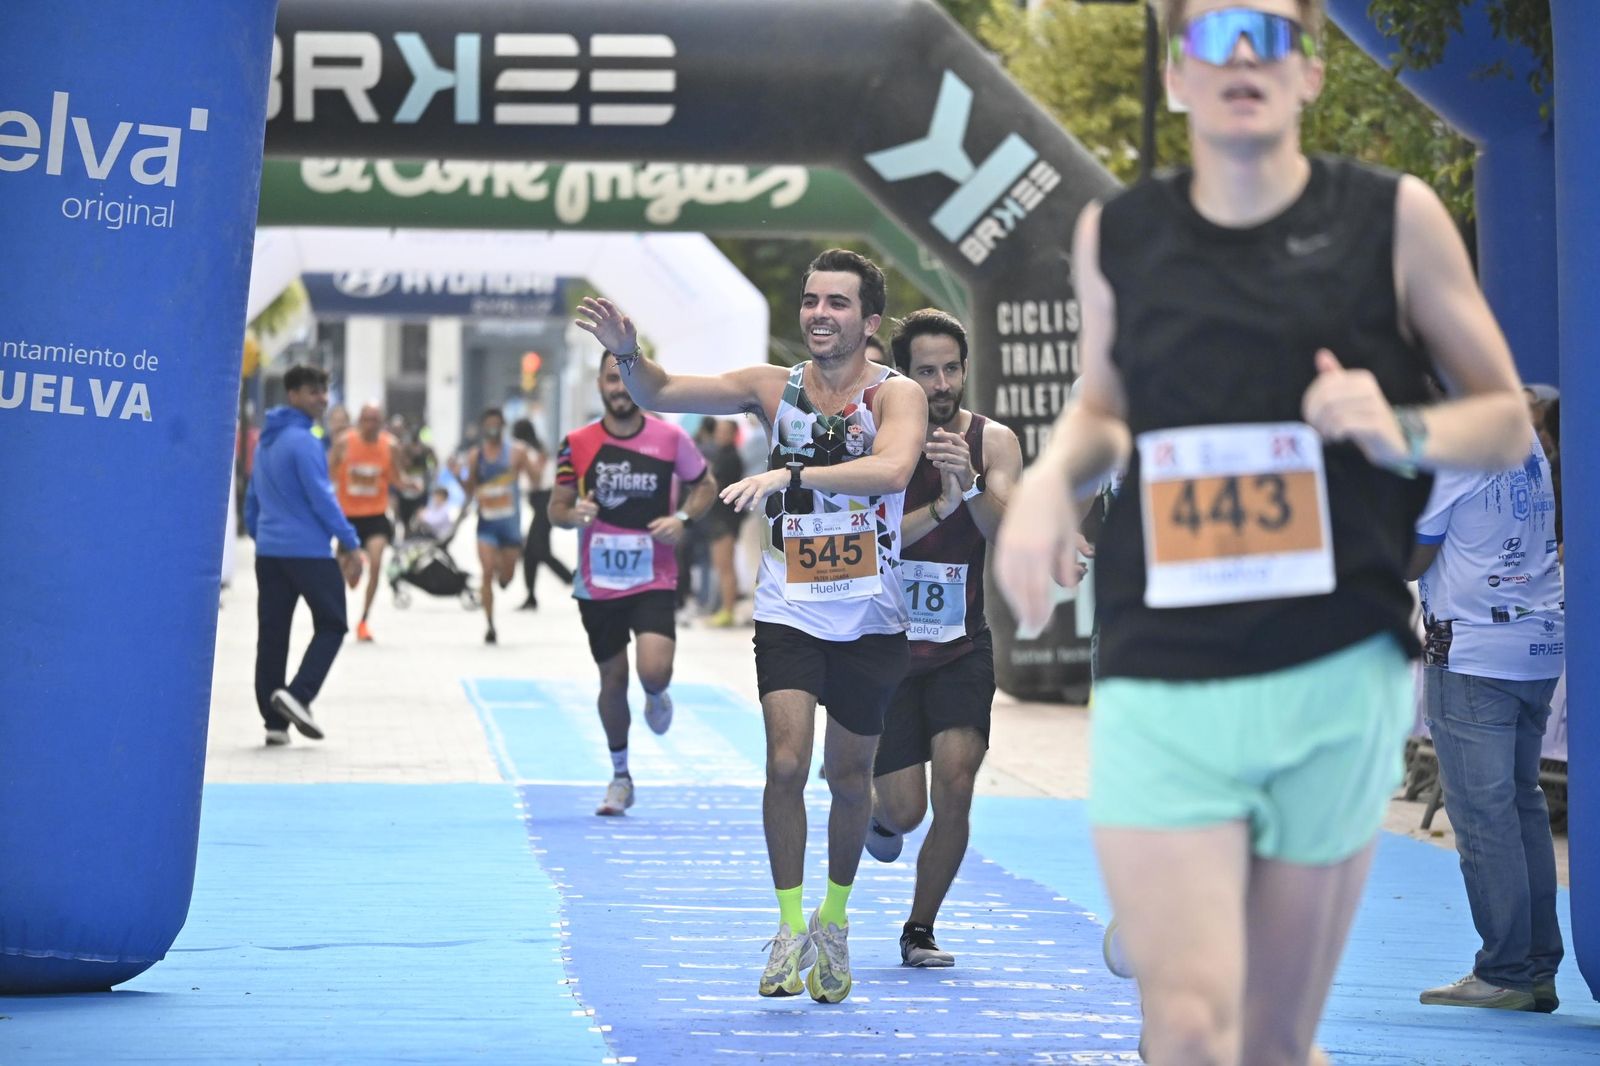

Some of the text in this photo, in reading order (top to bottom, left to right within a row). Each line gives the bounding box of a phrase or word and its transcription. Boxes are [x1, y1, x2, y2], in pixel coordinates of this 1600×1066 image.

[61, 193, 175, 230] original
[133, 350, 159, 371] de
[1171, 475, 1293, 534] 443
[787, 518, 803, 531] 2K
[851, 512, 870, 526] 2K
[602, 549, 643, 570] 107
[799, 535, 862, 569] 545
[946, 566, 963, 579] 2K
[810, 582, 850, 594] Huelva
[906, 581, 945, 612] 18
